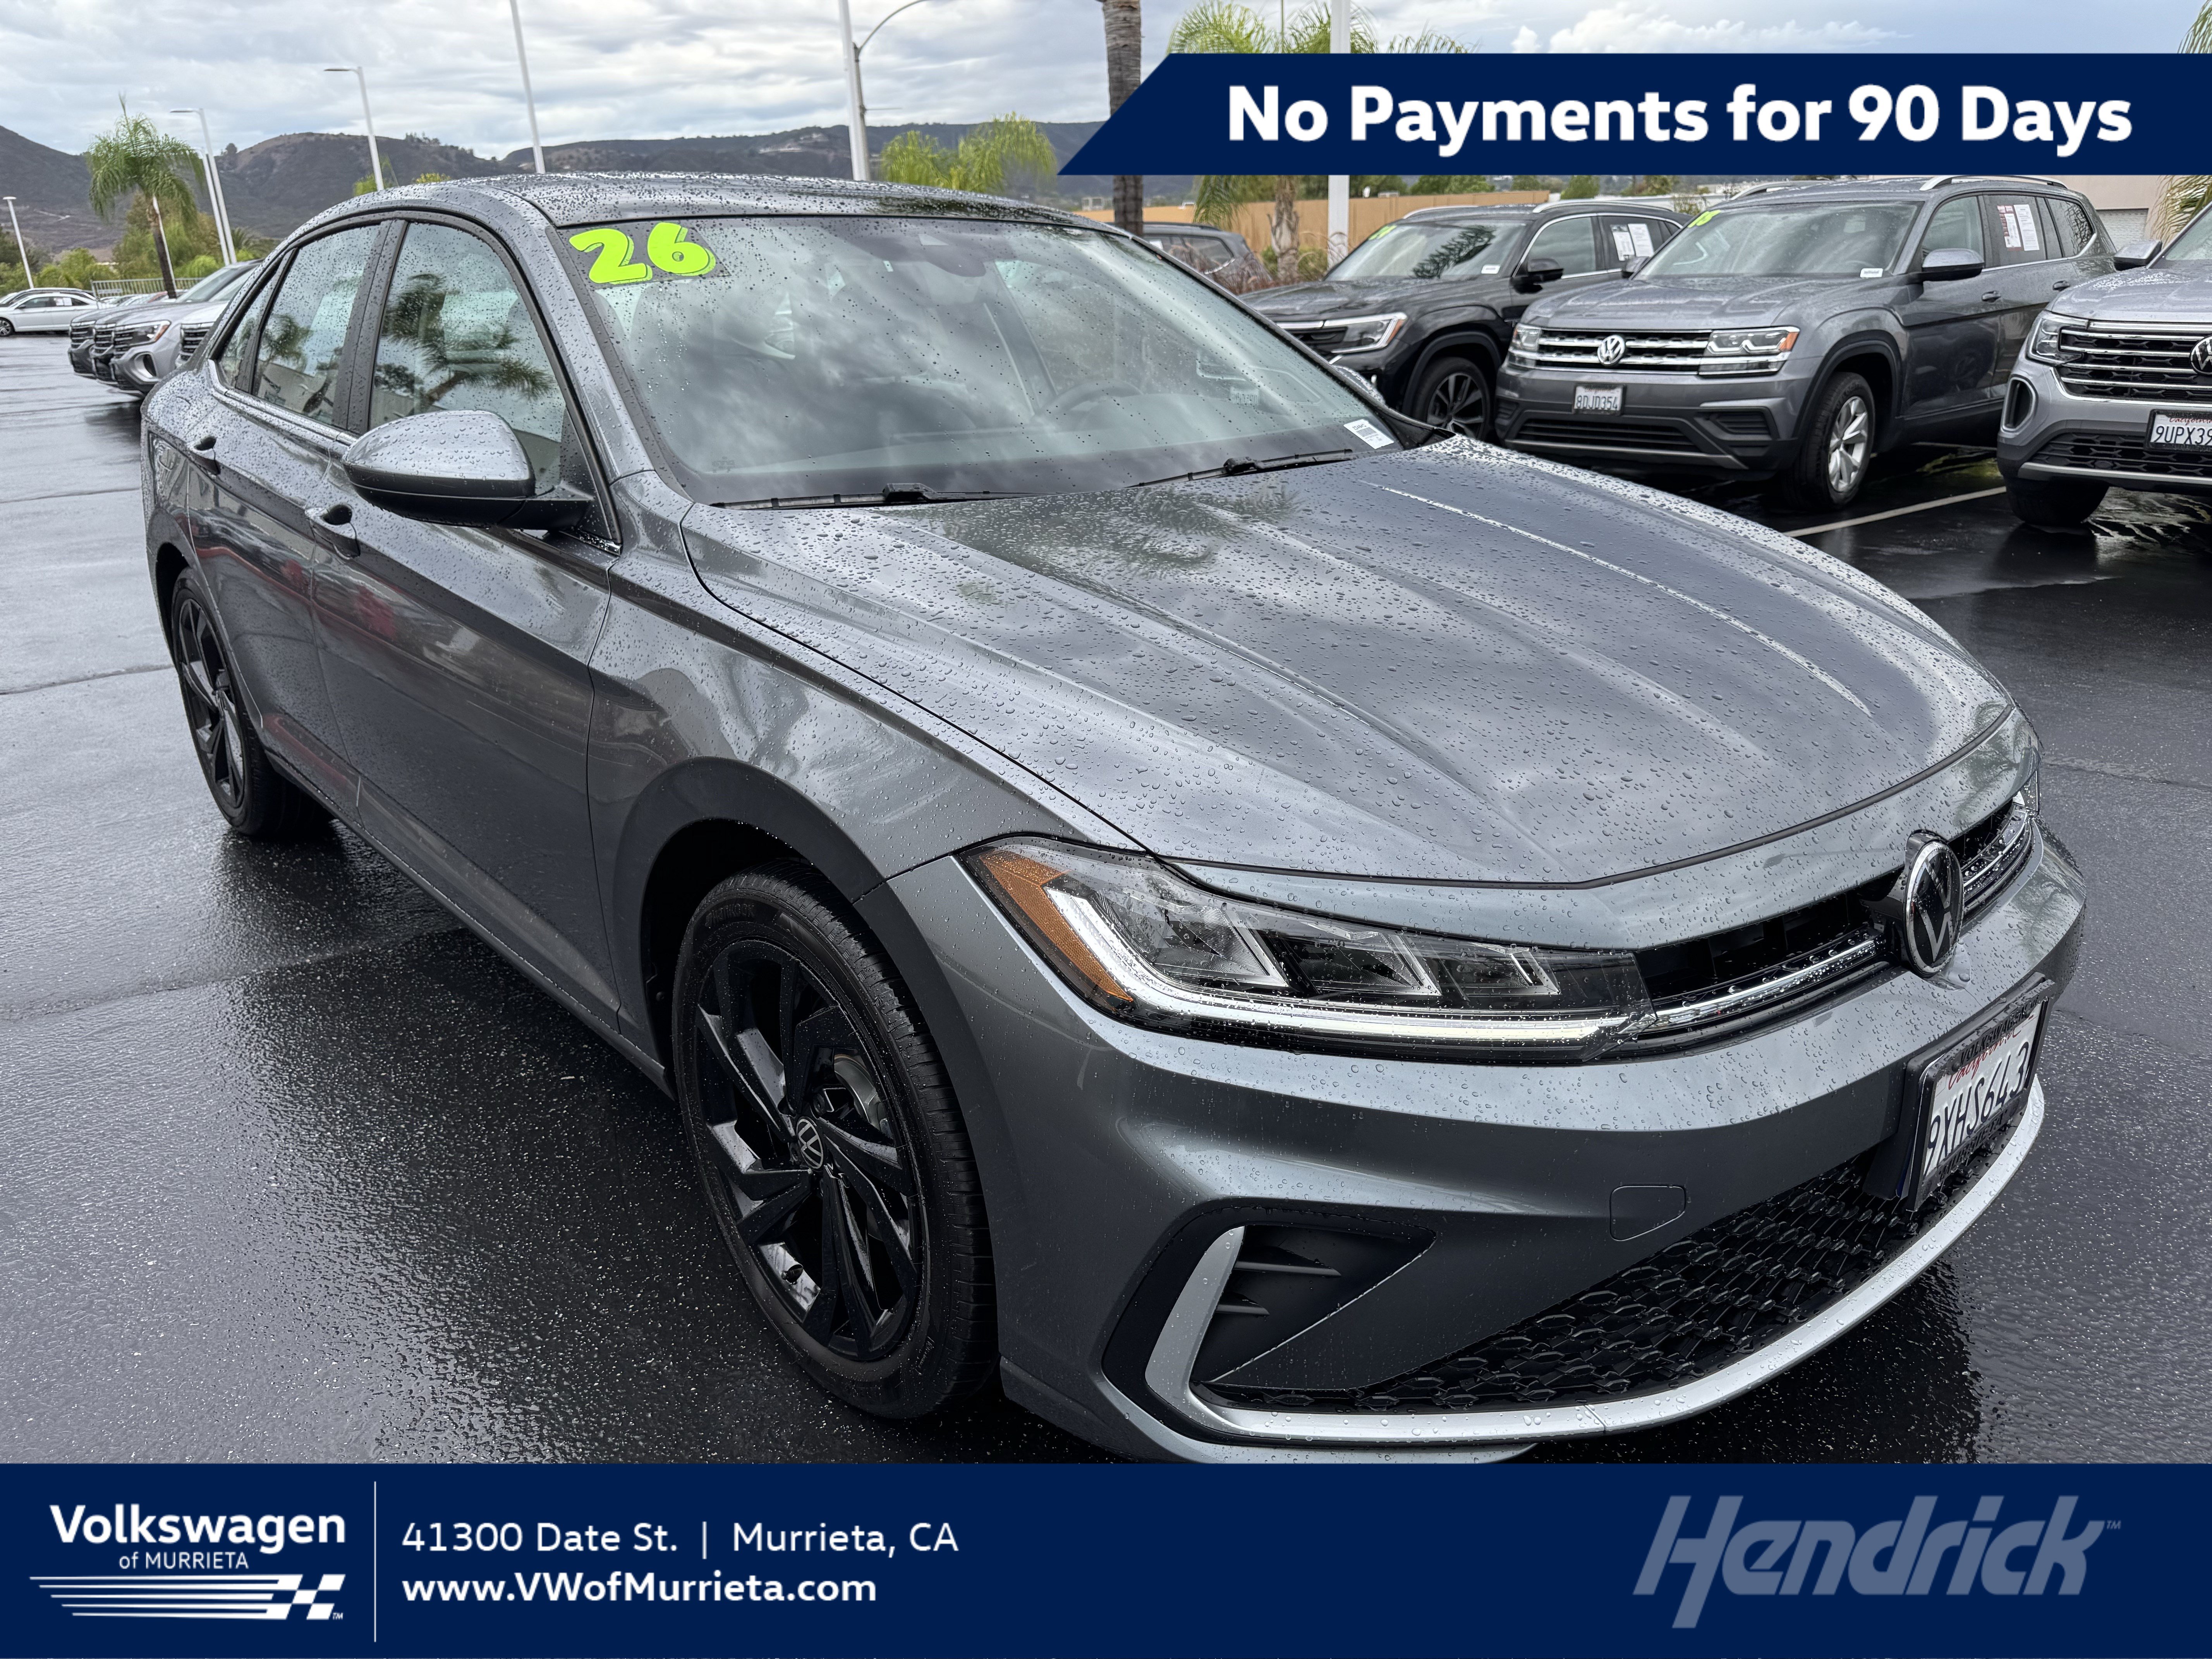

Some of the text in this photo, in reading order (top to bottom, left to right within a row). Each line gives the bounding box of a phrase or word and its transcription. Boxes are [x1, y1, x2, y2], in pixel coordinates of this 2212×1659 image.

[569, 222, 716, 284] 26
[1576, 395, 1618, 410] 8DJD354
[2154, 426, 2212, 446] 9UPX39
[1923, 1041, 2029, 1179] 9XHS643
